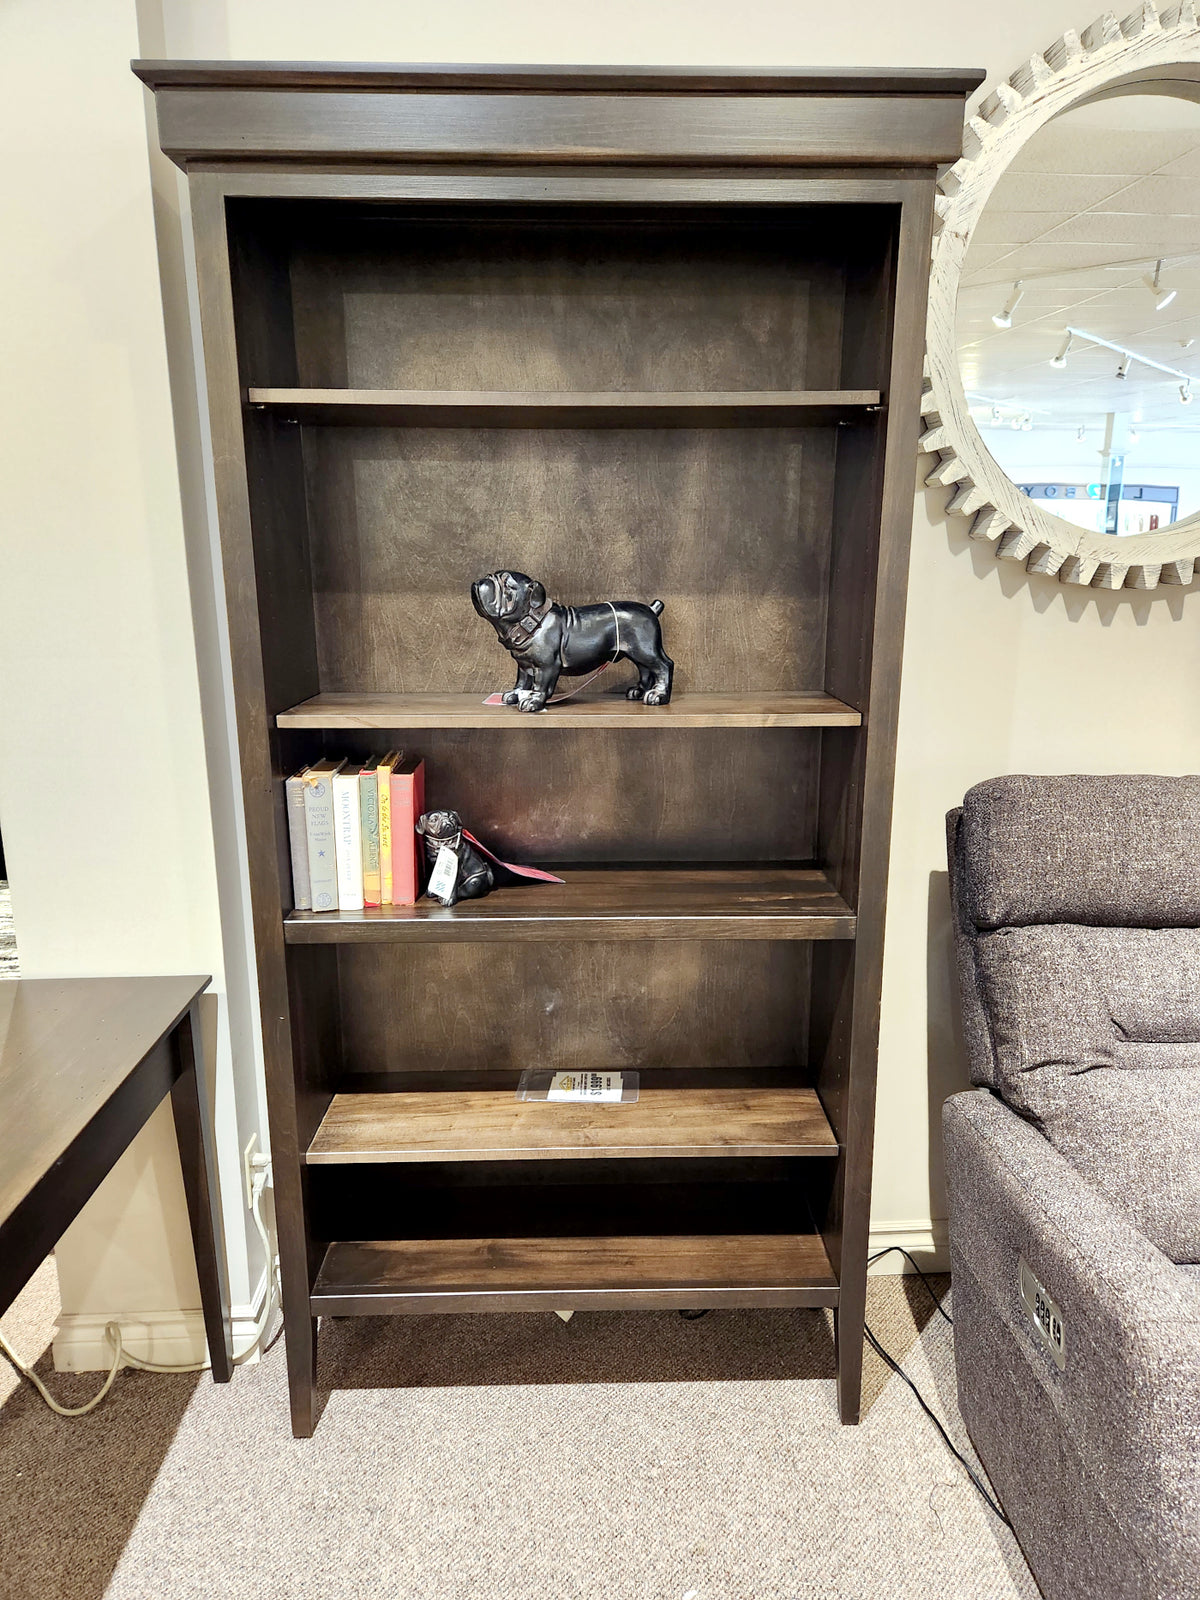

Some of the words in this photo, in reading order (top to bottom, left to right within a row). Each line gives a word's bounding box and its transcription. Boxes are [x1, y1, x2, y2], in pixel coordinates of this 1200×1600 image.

[341, 791, 352, 845] MOONTRAP
[367, 788, 375, 825] VICTORIA
[369, 840, 377, 867] ALBERT
